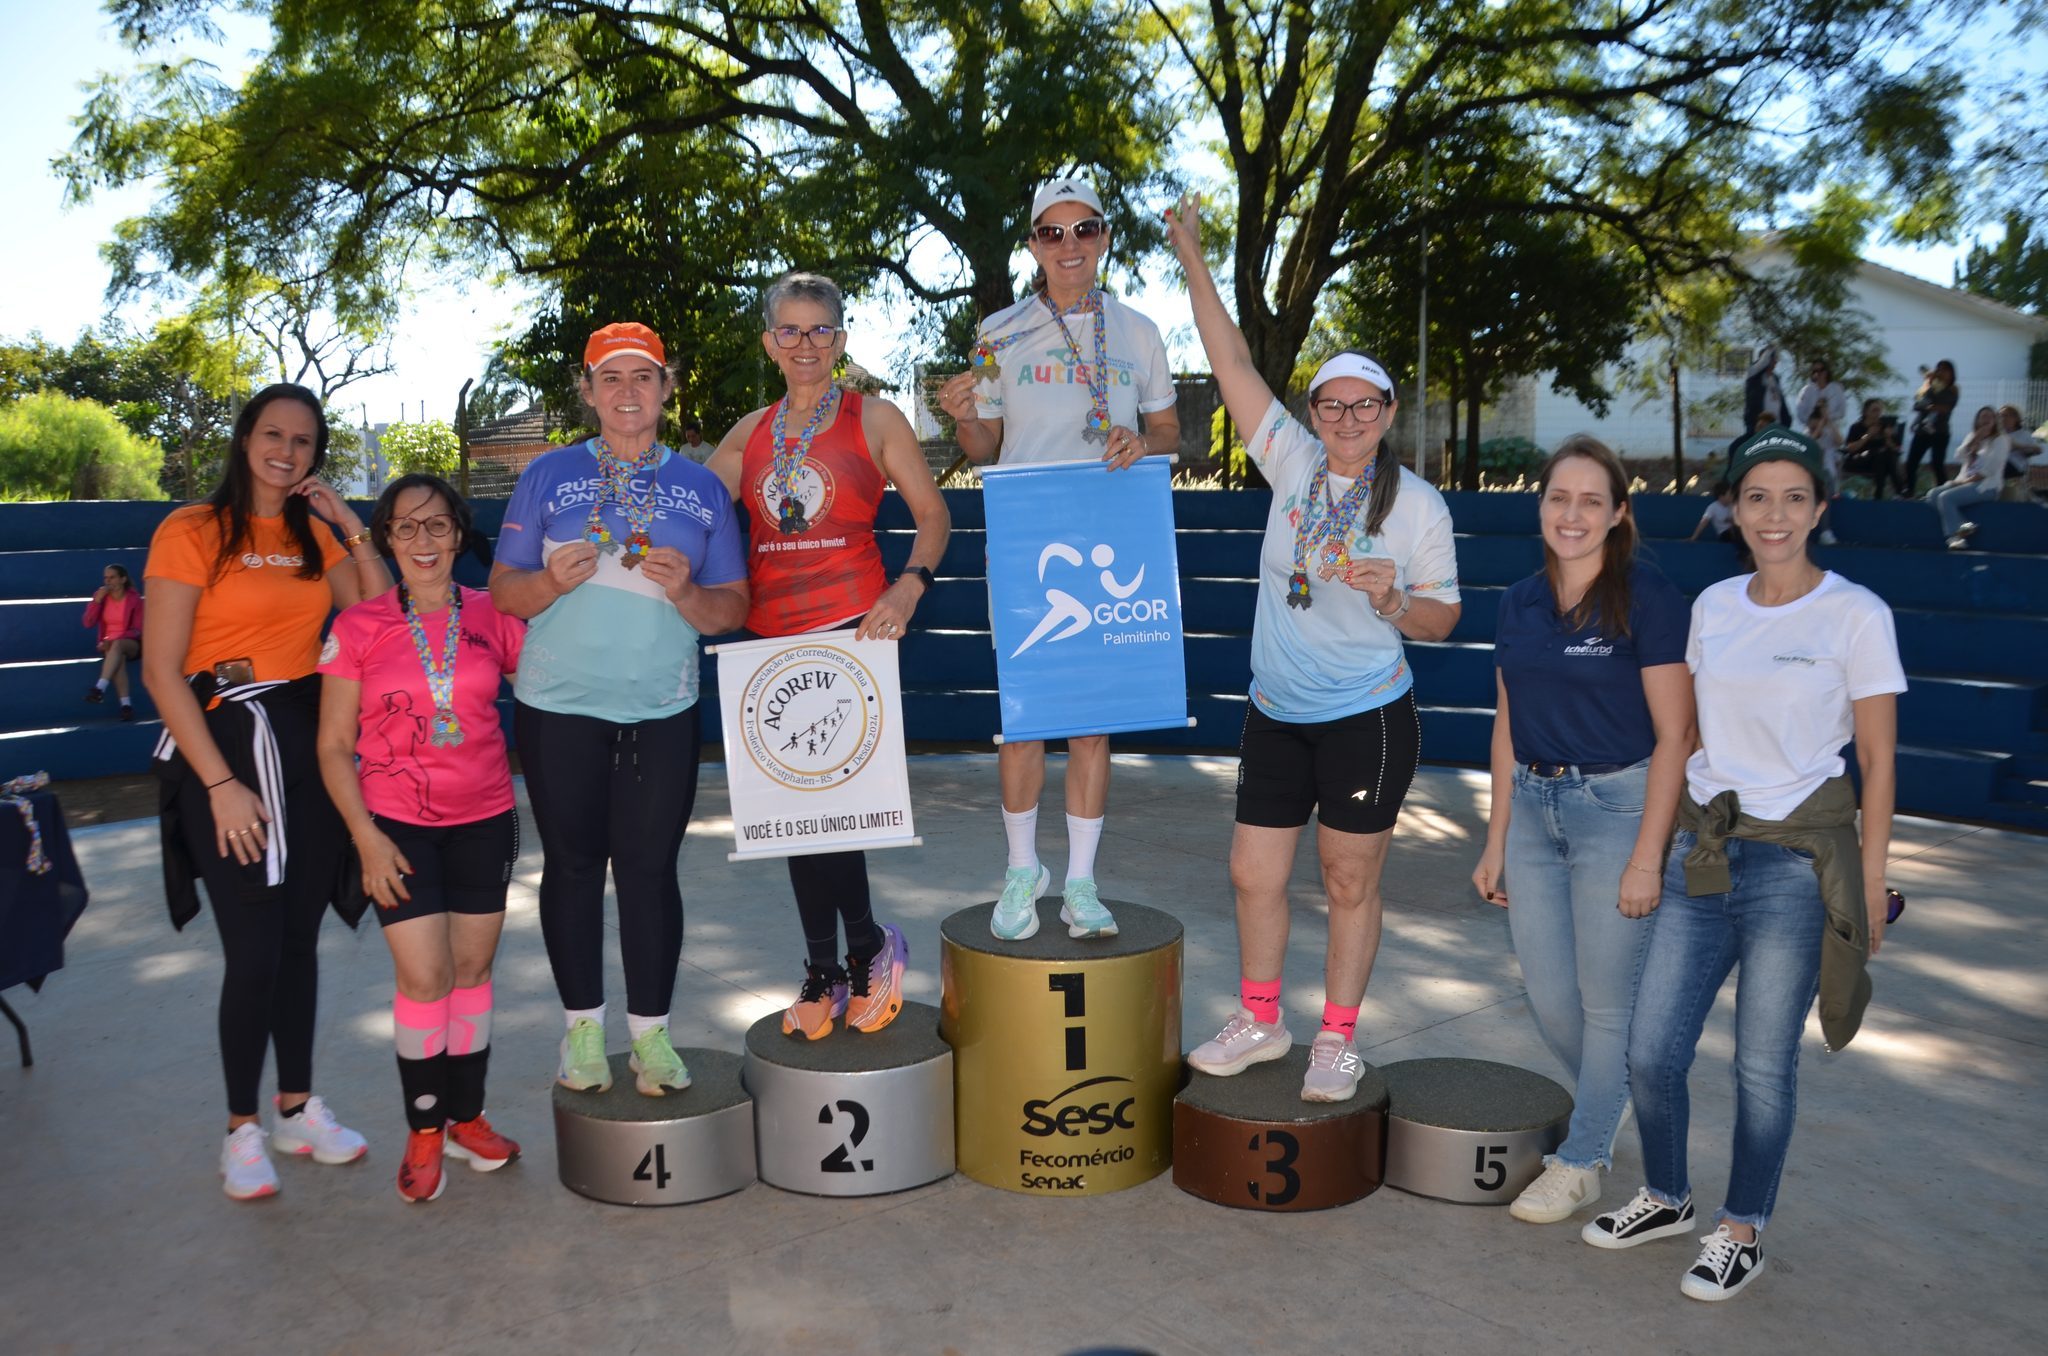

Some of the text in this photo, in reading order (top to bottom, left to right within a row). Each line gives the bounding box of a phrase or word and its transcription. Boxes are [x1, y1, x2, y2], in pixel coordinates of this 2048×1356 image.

[556, 477, 702, 505] RÚSCA DA
[1094, 599, 1168, 625] GCOR
[1103, 630, 1171, 645] Palmitinho
[748, 649, 868, 700] Associação de Corredores de Rua
[764, 670, 837, 731] ACORFW
[746, 720, 767, 762] Frederico
[852, 714, 879, 766] Desde 2024
[743, 810, 904, 840] VOCÊ É O SEU ÚNICO LIMITE!
[1049, 972, 1087, 1071] 1
[818, 1100, 874, 1173] 2
[1020, 1092, 1135, 1137] Sesc
[633, 1143, 672, 1189] 4
[1020, 1145, 1135, 1168] Fecomércio
[1247, 1129, 1300, 1206] 3
[1474, 1145, 1509, 1191] 5
[1021, 1172, 1085, 1190] Senac
